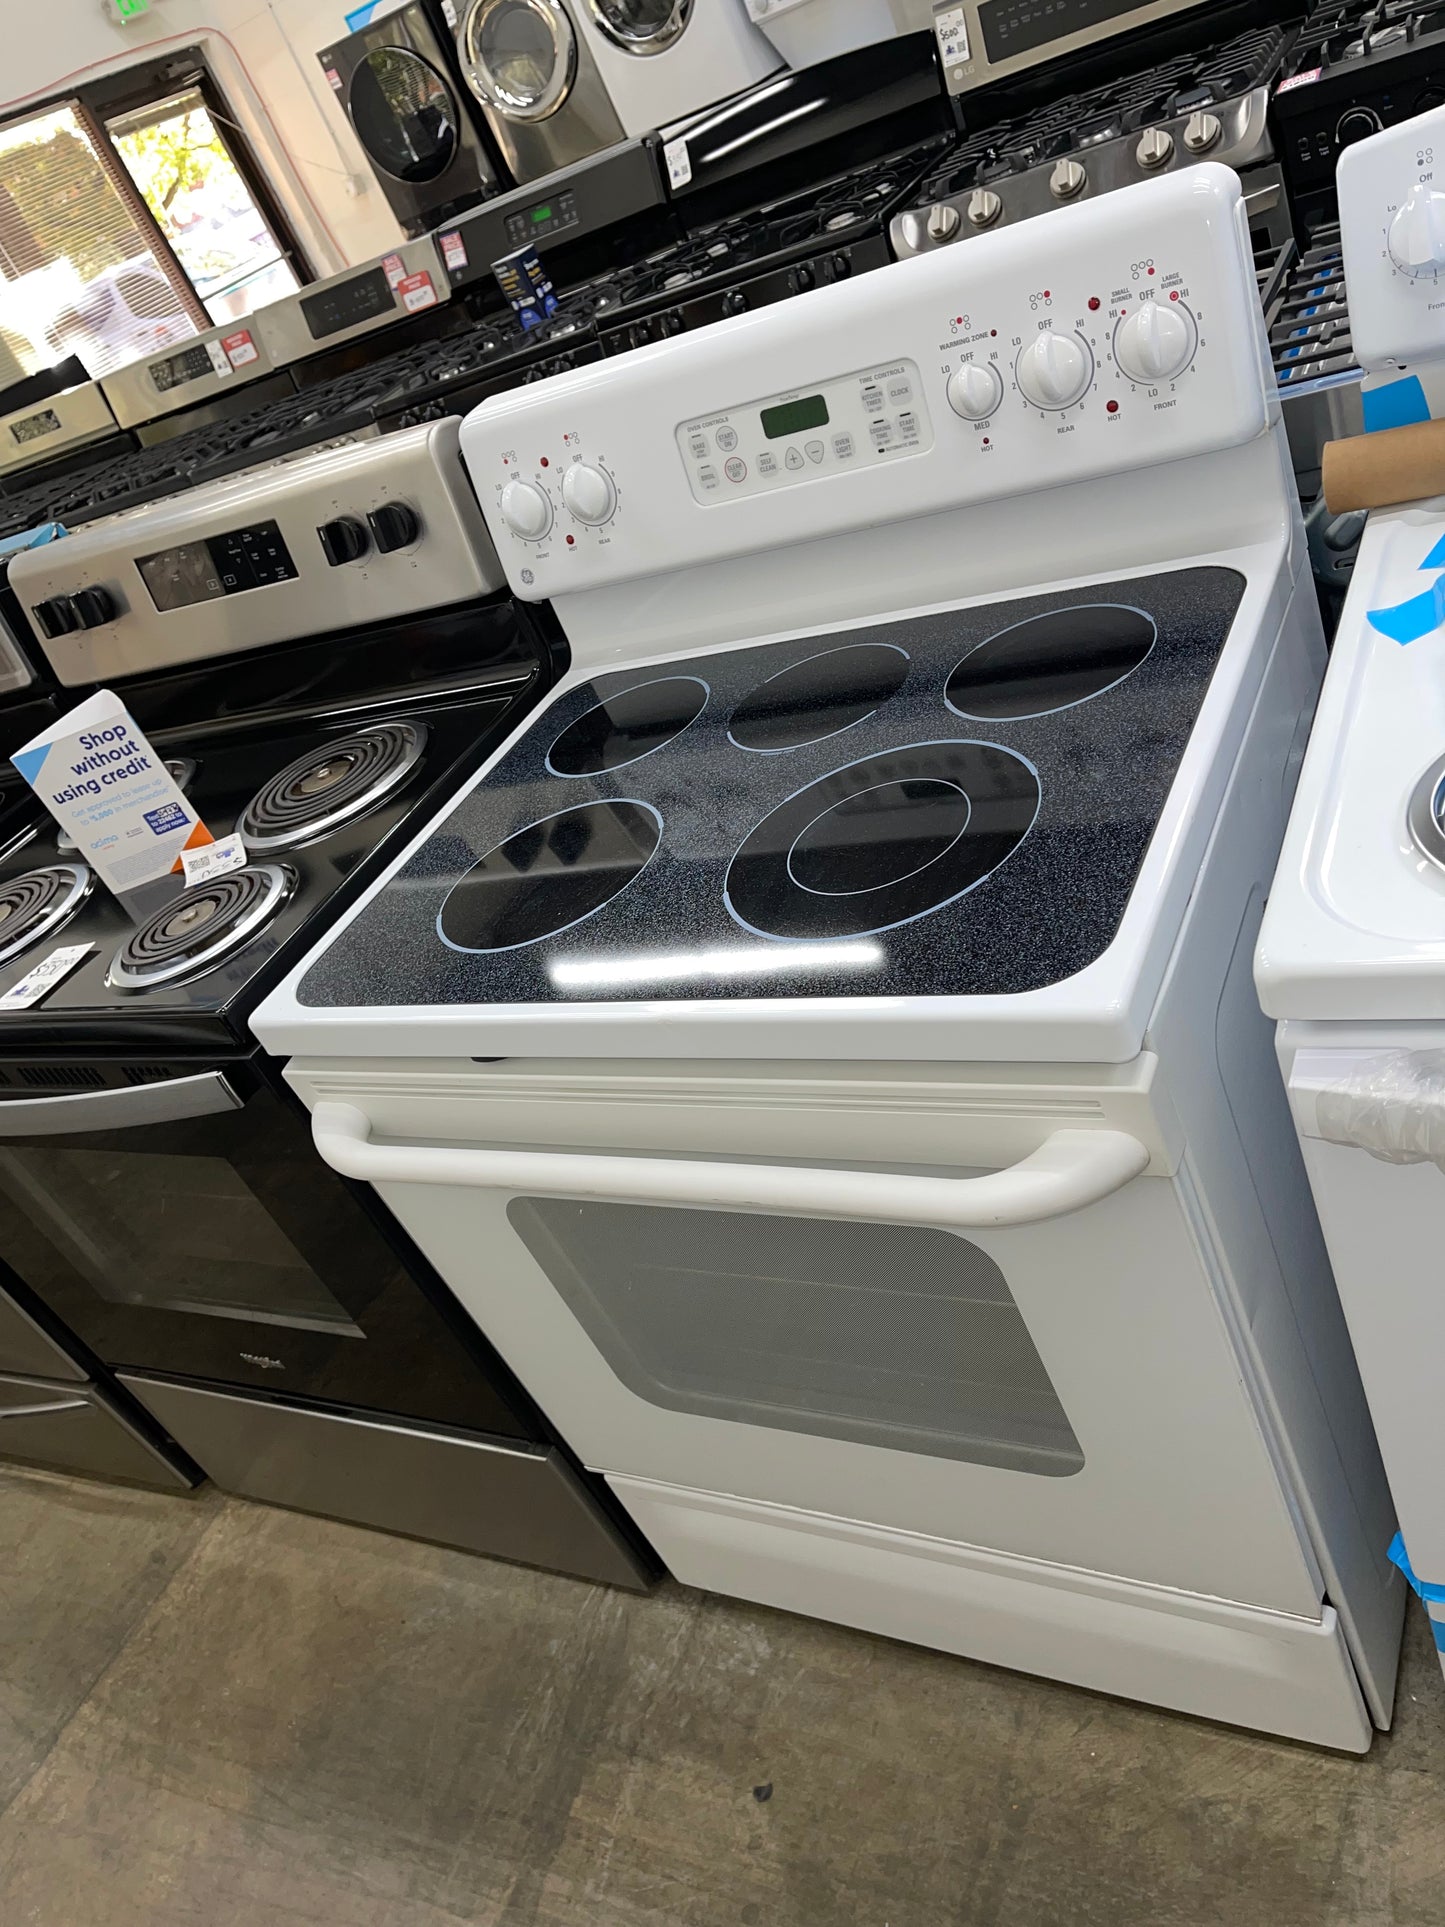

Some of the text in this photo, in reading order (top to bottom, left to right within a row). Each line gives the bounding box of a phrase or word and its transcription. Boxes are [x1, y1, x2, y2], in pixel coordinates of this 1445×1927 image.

[964, 66, 975, 76] LG
[1419, 172, 1433, 183] Off
[1387, 204, 1397, 212] Lo
[1382, 250, 1387, 258] 2
[1162, 272, 1180, 283] LARGE
[1433, 278, 1438, 286] 5
[1160, 278, 1184, 290] BURNER
[1111, 287, 1130, 298] SMALL
[1139, 289, 1156, 301] OFF
[1179, 288, 1190, 298] HI
[1110, 293, 1133, 305] BURNER
[1108, 309, 1118, 319] HI
[1197, 312, 1203, 320] 8
[1038, 319, 1053, 331] OFF
[1075, 318, 1085, 328] HI
[939, 331, 989, 351] WARMING ZONE
[1105, 332, 1111, 340] 8
[1011, 336, 1022, 347] LO
[1091, 338, 1096, 346] 9
[1200, 338, 1206, 347] 6
[960, 351, 975, 363] OFF
[990, 351, 999, 361] HI
[1107, 353, 1112, 361] 6
[941, 364, 951, 374] LO
[1096, 360, 1102, 368] 8
[1190, 364, 1196, 373] 4
[859, 366, 905, 385] TIME CONTROLS
[1115, 371, 1120, 379] 4
[1011, 382, 1017, 390] 2
[1093, 383, 1098, 392] 7
[1131, 384, 1136, 392] 2
[1170, 383, 1176, 391] 2
[890, 386, 909, 397] CLOCK
[1148, 388, 1159, 397] LO
[1023, 401, 1028, 409] 3
[1080, 402, 1085, 410] 6
[1153, 399, 1177, 411] FRONT
[1040, 411, 1045, 419] 4
[1061, 412, 1066, 420] 5
[1107, 413, 1121, 422] HOT
[686, 416, 729, 433] OVEN CONTROLS
[974, 420, 991, 431] MED
[1057, 424, 1075, 434] REAR
[834, 437, 850, 446] OVEN
[980, 444, 994, 453] HOT
[572, 453, 583, 463] OFF
[556, 466, 564, 474] LO
[759, 464, 776, 473] CLEAN
[510, 471, 521, 480] OFF
[79, 724, 127, 750] Shop
[70, 740, 140, 776] without
[52, 779, 102, 804] using
[71, 807, 87, 818] Get
[87, 794, 122, 813] approved
[122, 790, 131, 798] to
[80, 817, 90, 826] to
[155, 822, 171, 834] apply
[90, 834, 119, 850] acima
